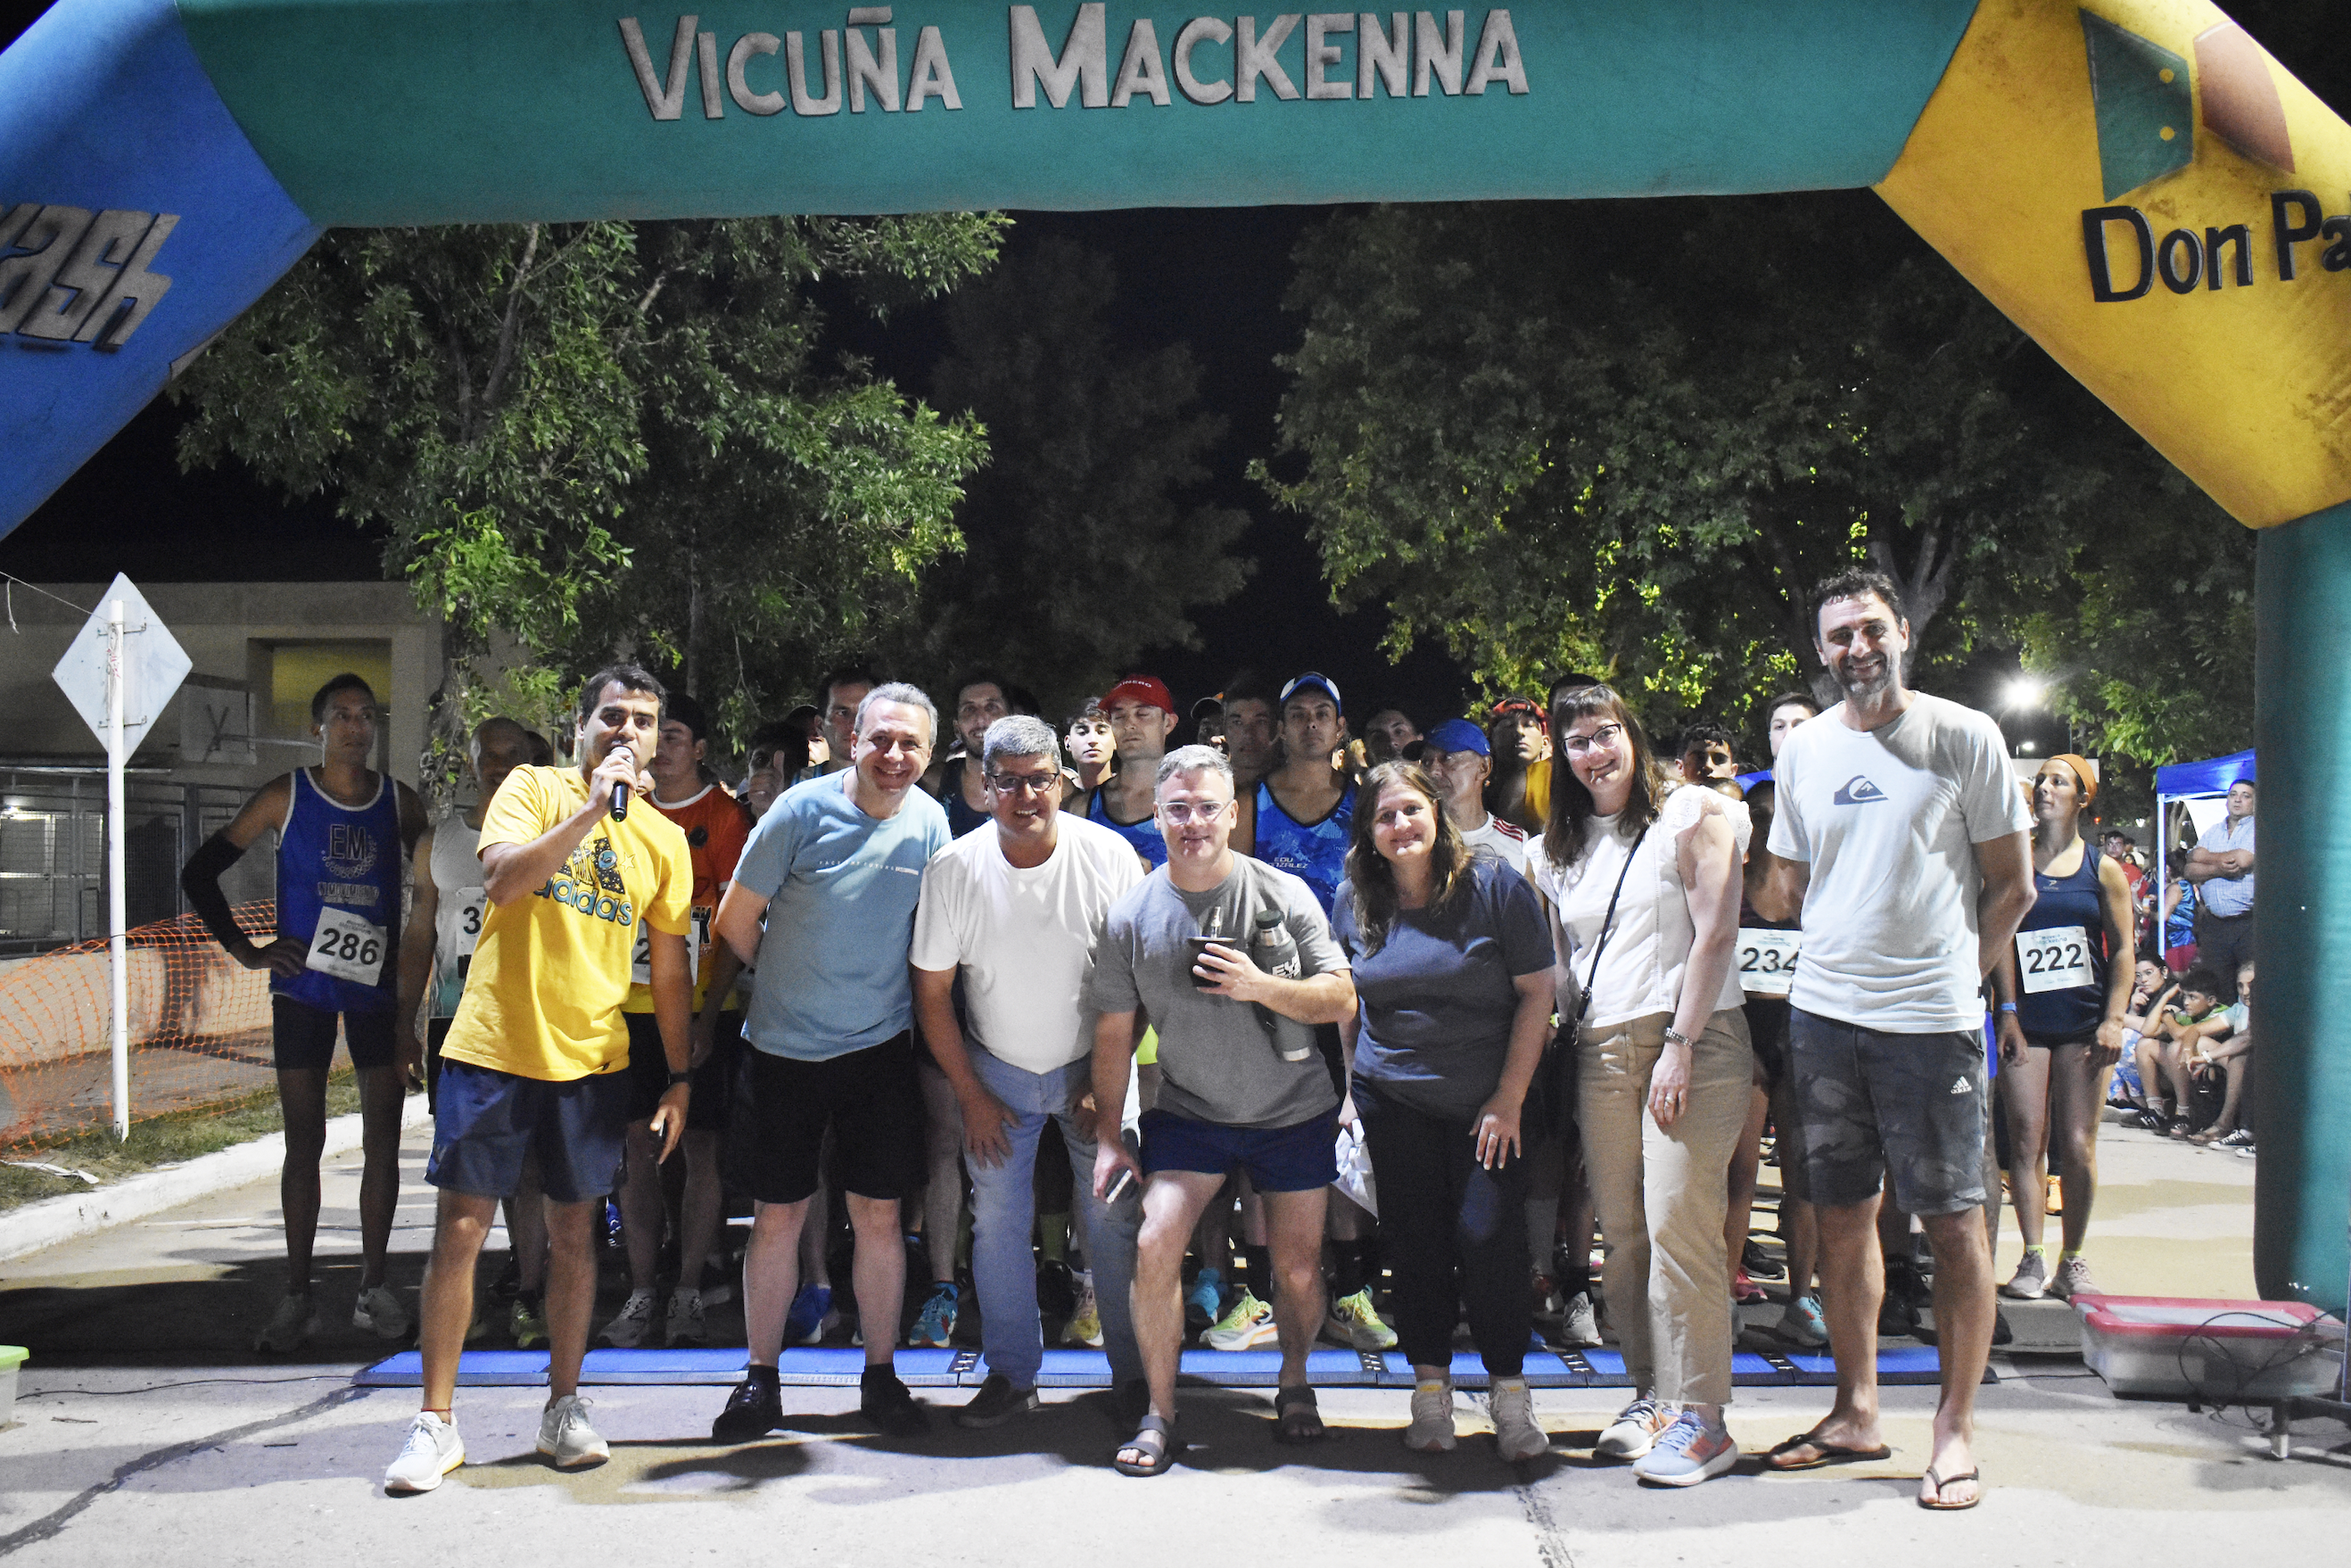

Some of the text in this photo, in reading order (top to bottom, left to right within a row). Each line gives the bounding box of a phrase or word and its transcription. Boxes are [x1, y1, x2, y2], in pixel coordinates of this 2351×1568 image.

[618, 3, 1530, 120] VICUÑA MACKENNA
[2082, 189, 2351, 302] Don Pa
[330, 824, 366, 860] EM
[317, 928, 380, 965] 286
[1739, 947, 1799, 973] 234
[2026, 944, 2084, 974] 222
